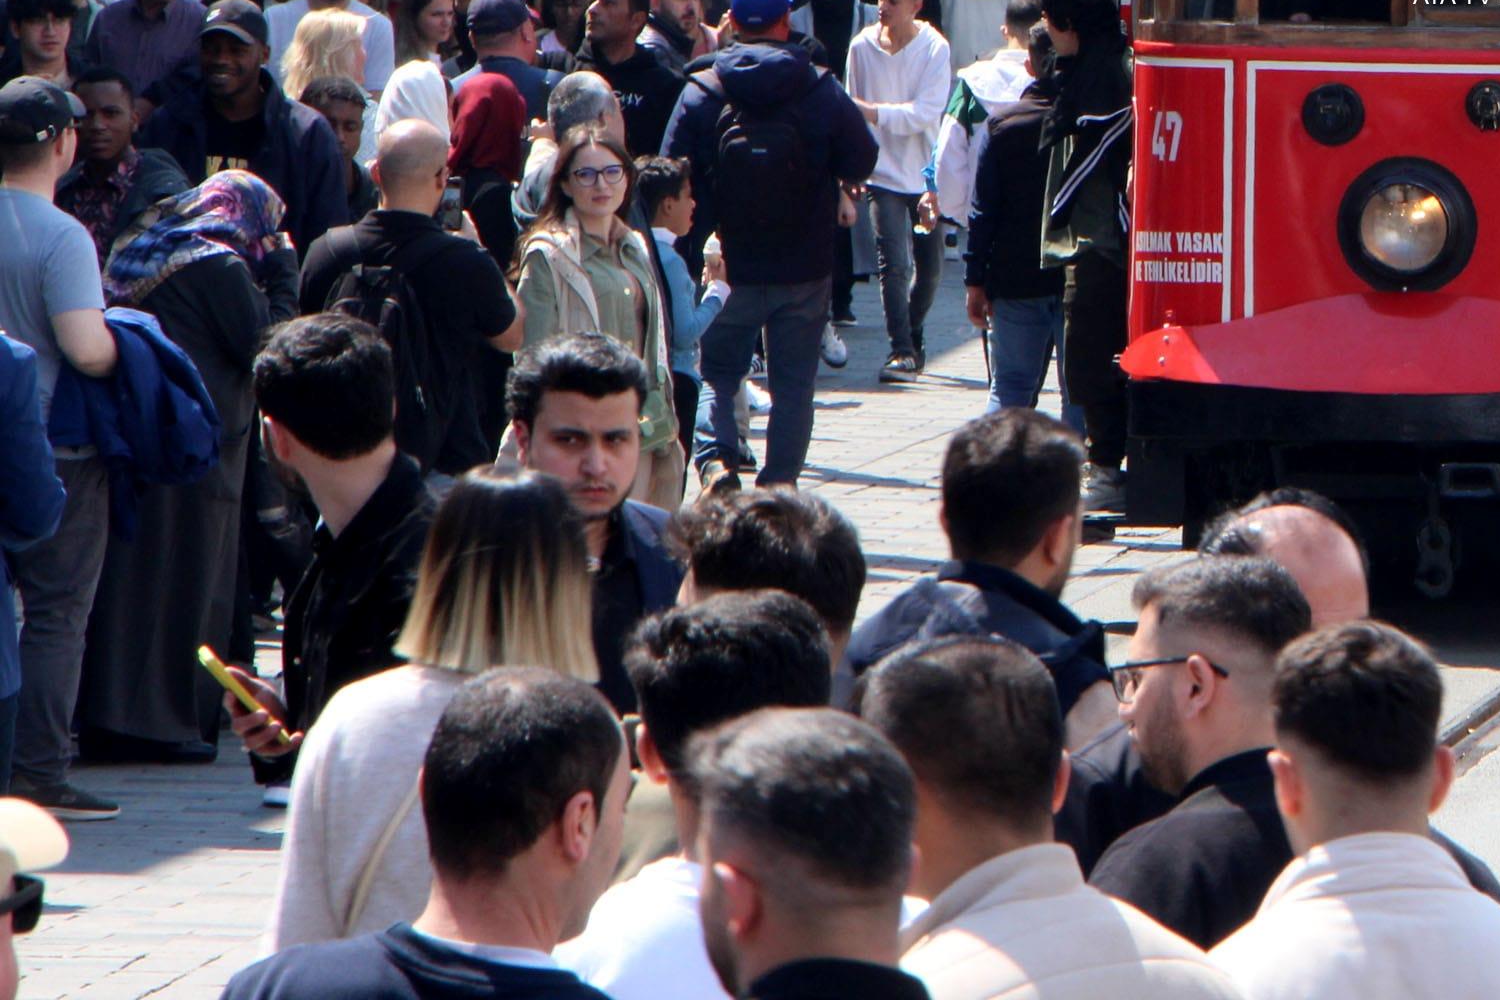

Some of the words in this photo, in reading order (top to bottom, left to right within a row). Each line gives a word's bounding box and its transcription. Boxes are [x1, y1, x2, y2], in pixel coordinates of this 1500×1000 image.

[1152, 111, 1183, 162] 47
[1176, 232, 1223, 253] YASAK
[1144, 257, 1223, 283] TEHLİKELİDİR
